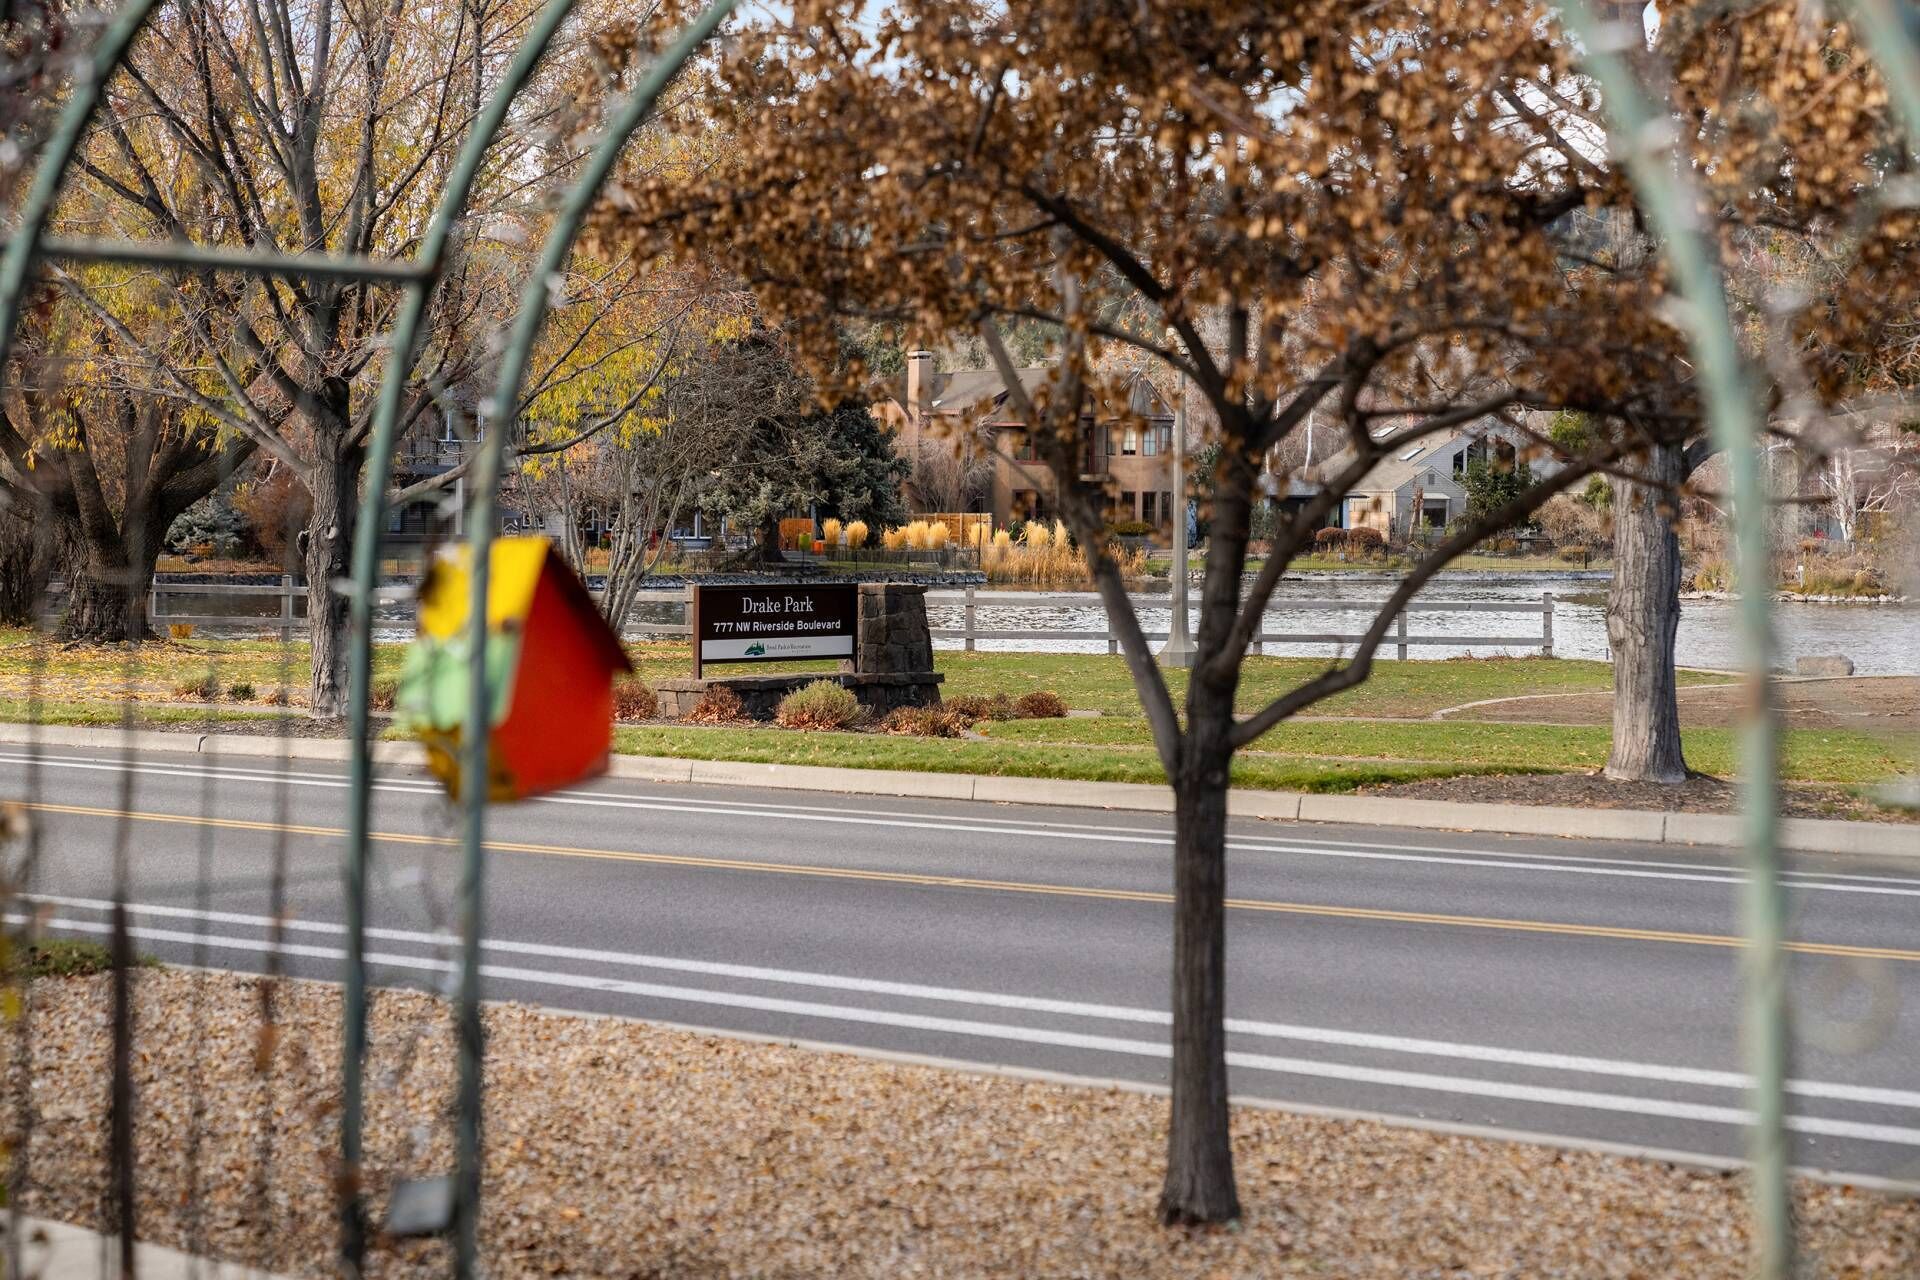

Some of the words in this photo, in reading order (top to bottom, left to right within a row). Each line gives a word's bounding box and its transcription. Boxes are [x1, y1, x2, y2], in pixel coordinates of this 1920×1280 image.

[742, 597, 781, 614] Drake
[784, 596, 814, 613] Park
[713, 622, 733, 632] 777
[736, 622, 750, 632] NW
[753, 621, 794, 631] Riverside
[797, 620, 841, 630] Boulevard
